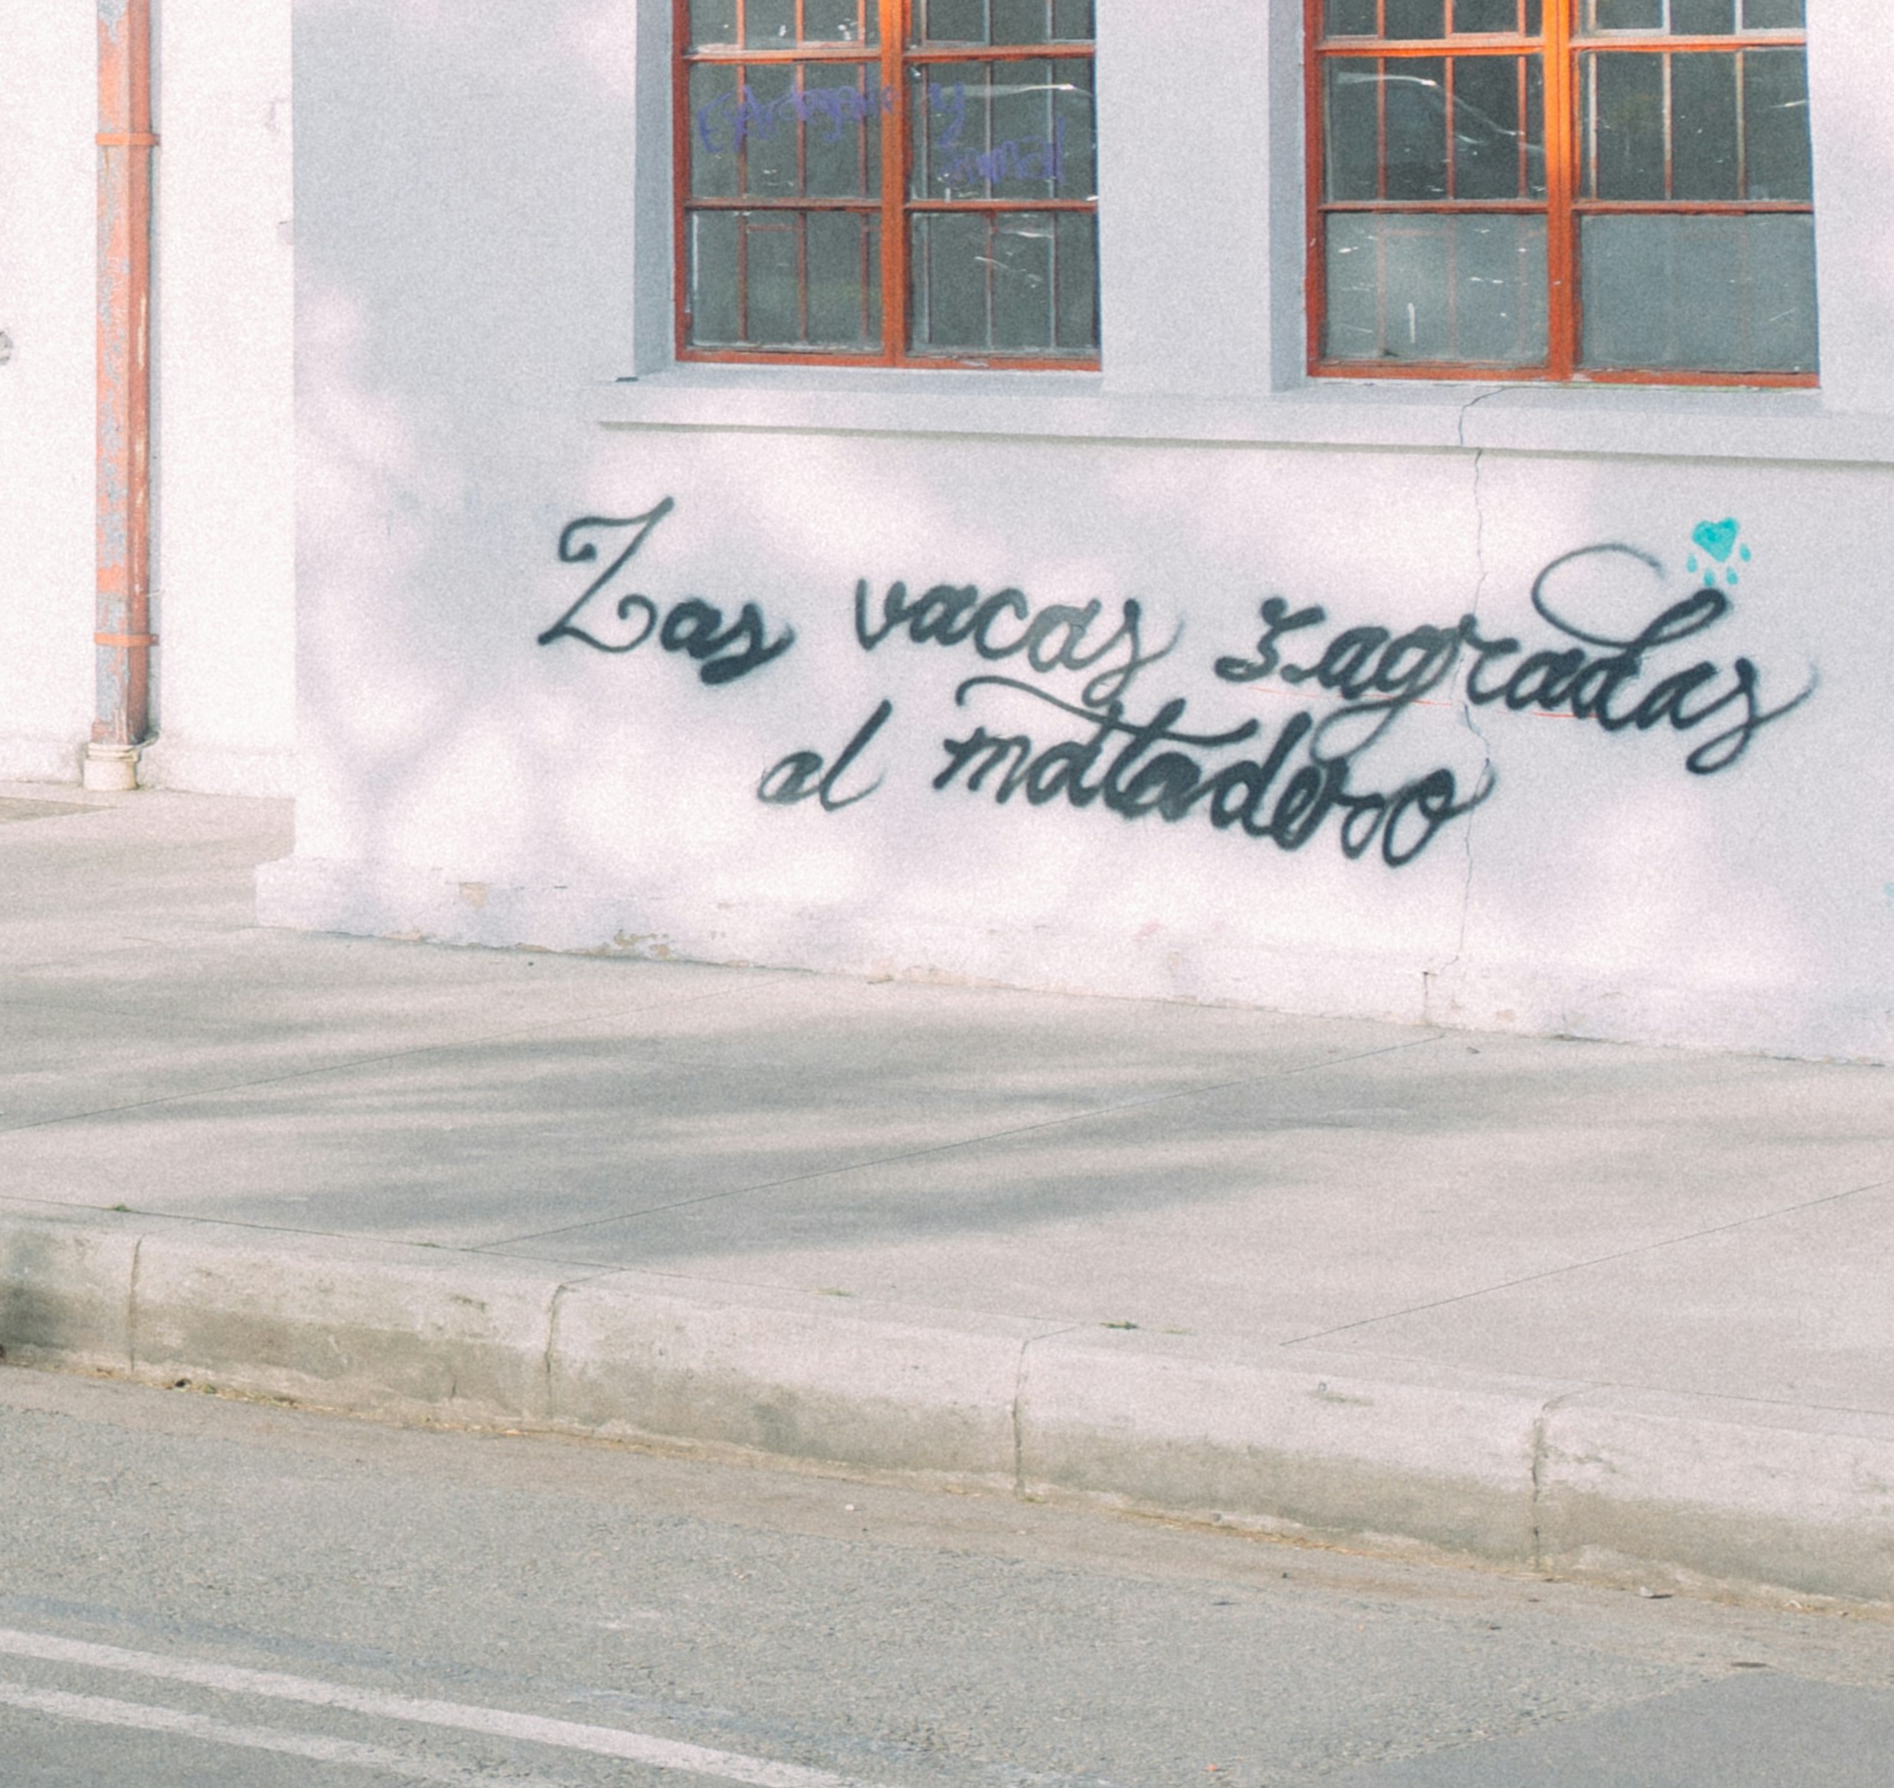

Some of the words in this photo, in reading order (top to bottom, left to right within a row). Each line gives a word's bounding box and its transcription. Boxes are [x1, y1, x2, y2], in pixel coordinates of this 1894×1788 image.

[856, 578, 1186, 707] vacas
[756, 699, 893, 811] al
[932, 675, 1497, 868] matadero
